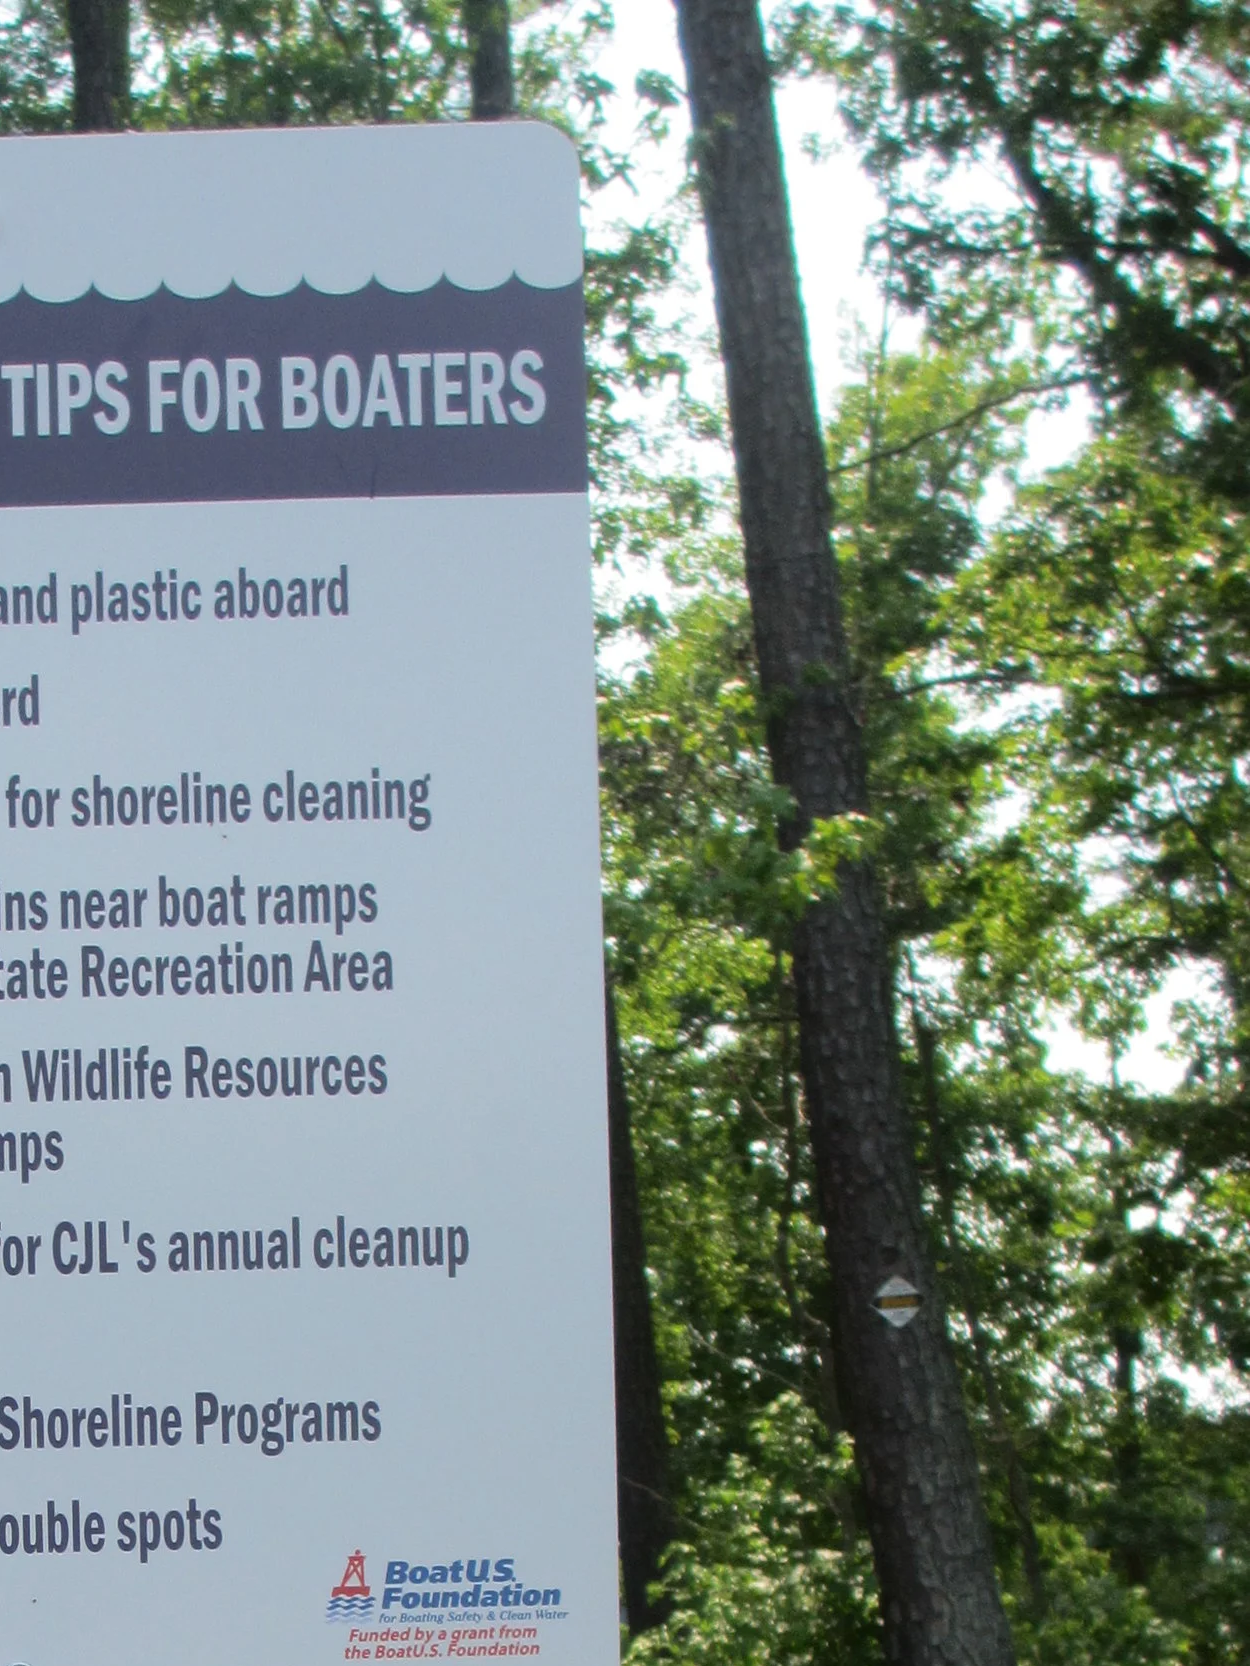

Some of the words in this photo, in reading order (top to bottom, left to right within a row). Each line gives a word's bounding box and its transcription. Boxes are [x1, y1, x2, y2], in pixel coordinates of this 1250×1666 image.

[1, 360, 131, 437] TIPS
[149, 357, 263, 433] FOR
[281, 350, 546, 430] BOATERS
[72, 569, 201, 635] plastic
[215, 565, 348, 619] aboard
[6, 775, 59, 828] for
[72, 772, 250, 826] shoreline
[263, 768, 431, 831] cleaning
[61, 889, 147, 929] near
[159, 875, 246, 927] boat
[258, 883, 377, 935] ramps
[82, 942, 292, 997] Recreation
[304, 940, 392, 992] Area
[22, 1046, 171, 1102] Wildlife
[185, 1046, 387, 1098] Resources
[53, 1221, 156, 1274] CJL's
[169, 1217, 300, 1272] annual
[314, 1216, 469, 1278] cleanup
[195, 1392, 381, 1456] Programs
[117, 1499, 222, 1563] spots
[379, 1613, 396, 1624] for
[399, 1611, 443, 1624] Boating
[447, 1611, 483, 1623] Safety
[486, 1611, 496, 1621] &
[499, 1609, 531, 1621] Clean
[536, 1609, 568, 1620] Water
[382, 1584, 560, 1609] Foundation
[345, 1646, 371, 1659] the
[375, 1644, 442, 1659] BoatU.S.
[447, 1642, 540, 1656] Foundation
[349, 1629, 409, 1642] Funded
[414, 1627, 433, 1642] by
[437, 1630, 446, 1640] a
[450, 1627, 495, 1643] grant
[499, 1625, 537, 1639] from
